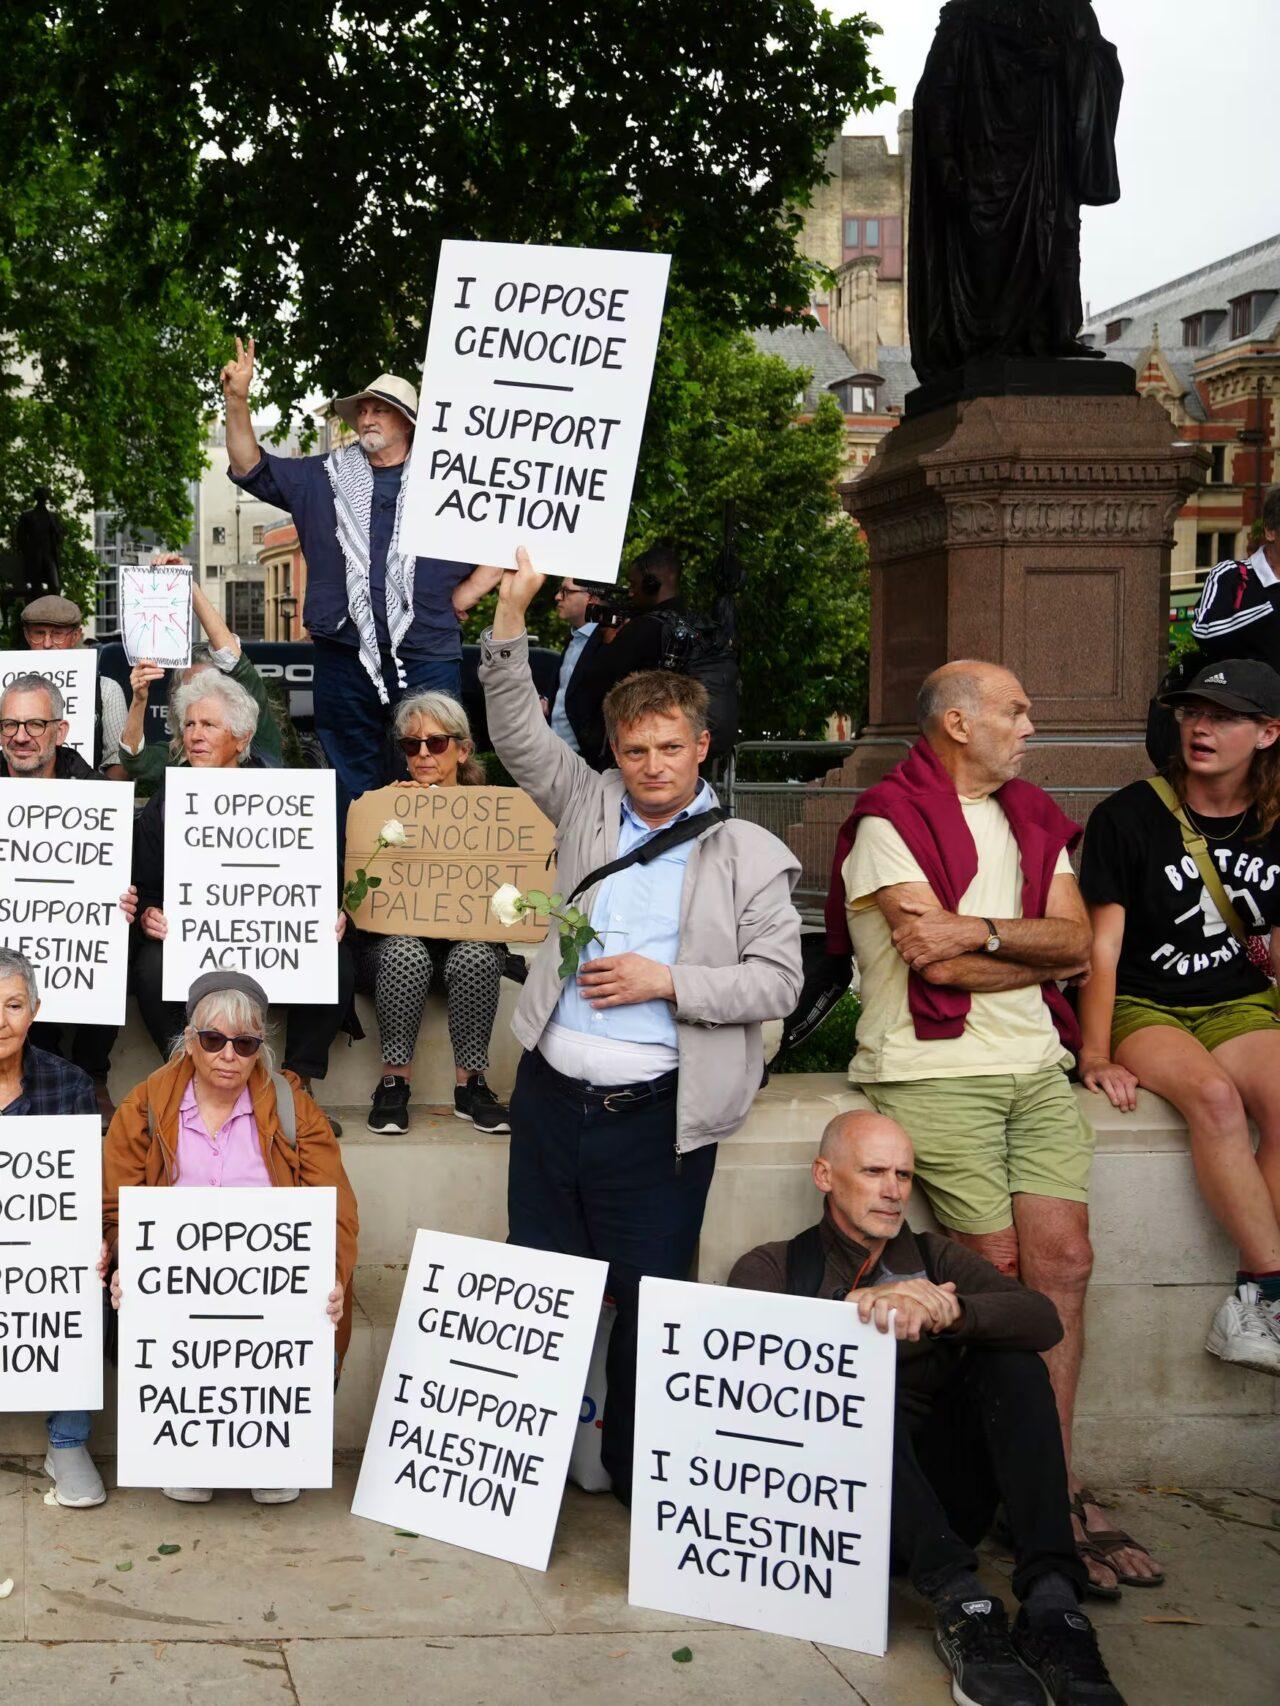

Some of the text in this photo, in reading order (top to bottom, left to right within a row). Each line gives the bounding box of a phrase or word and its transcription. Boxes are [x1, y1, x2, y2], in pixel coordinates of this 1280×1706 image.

[453, 276, 630, 322] I OPPOSE
[454, 325, 627, 370] GENOCIDE
[431, 400, 622, 450] I SUPPORT
[429, 449, 608, 502] PALESTINE
[434, 489, 581, 534] ACTION
[7, 804, 118, 831] OPPOSE
[185, 792, 315, 817] I OPPOSE
[394, 794, 513, 822] OPPOSE
[184, 826, 314, 850] GENOCIDE
[398, 824, 535, 851] ENOCIDE
[389, 862, 527, 892] SUPPORT
[1164, 848, 1280, 891] BOTERS
[179, 882, 322, 907] I SUPPORT
[181, 918, 319, 944] PALESTINE
[199, 947, 299, 970] ACTION
[135, 1220, 312, 1252] I OPPOSE
[137, 1265, 310, 1296] GENOCIDE
[422, 1263, 575, 1320] I OPPOSE
[134, 1338, 314, 1370] I SUPPORT
[418, 1307, 565, 1362] GENOCIDE
[661, 1322, 859, 1379] I OPPOSE
[139, 1384, 312, 1415] PALESTINE
[394, 1373, 414, 1404] I
[420, 1380, 558, 1437] SUPPORT
[665, 1371, 866, 1429] GENOCIDE
[152, 1418, 290, 1449] ACTION
[389, 1420, 544, 1486] PALESTINE
[395, 1460, 516, 1516] ACTION
[650, 1449, 868, 1513] I SUPPORT
[657, 1501, 861, 1565] PALESTINE
[677, 1544, 832, 1599] ACTION
